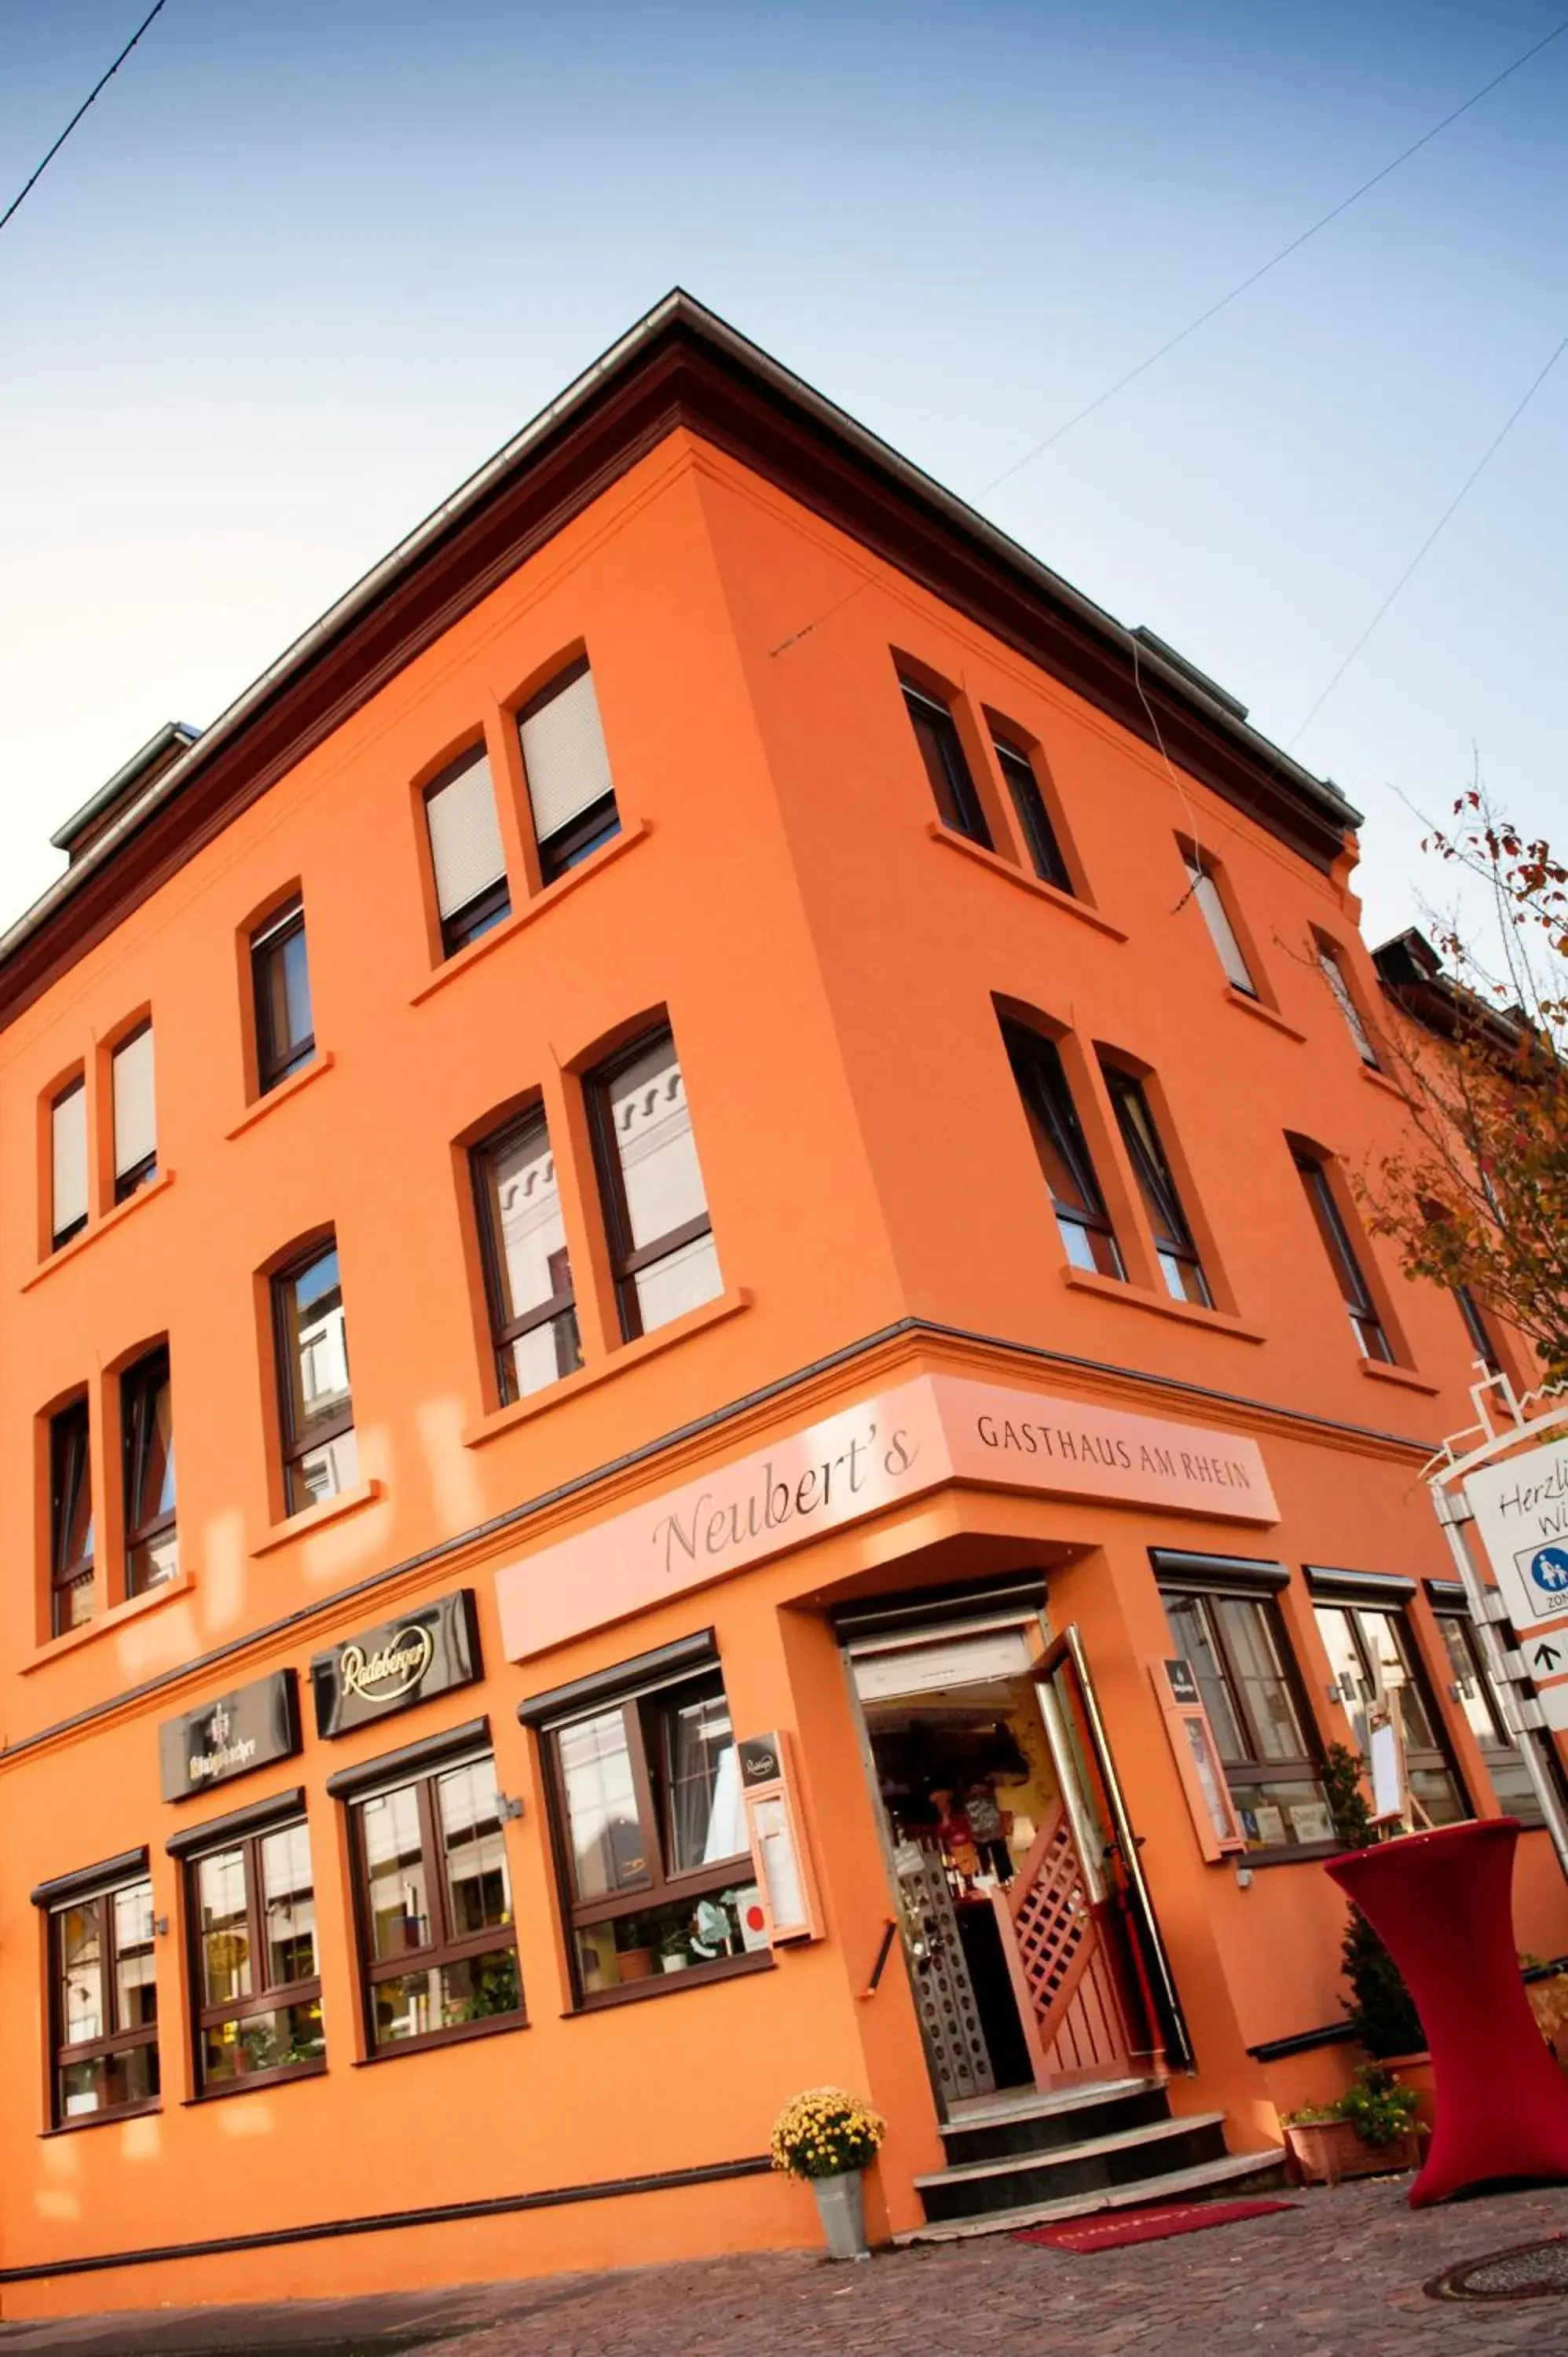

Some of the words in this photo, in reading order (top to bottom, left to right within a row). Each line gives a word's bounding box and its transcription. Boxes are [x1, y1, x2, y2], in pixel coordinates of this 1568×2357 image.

[977, 1417, 1130, 1469] GASTHAUS
[1141, 1446, 1178, 1478] AM
[1180, 1453, 1251, 1490] RHEIN
[651, 1423, 921, 1573] Neubert's
[341, 1636, 430, 1699] Radeberger
